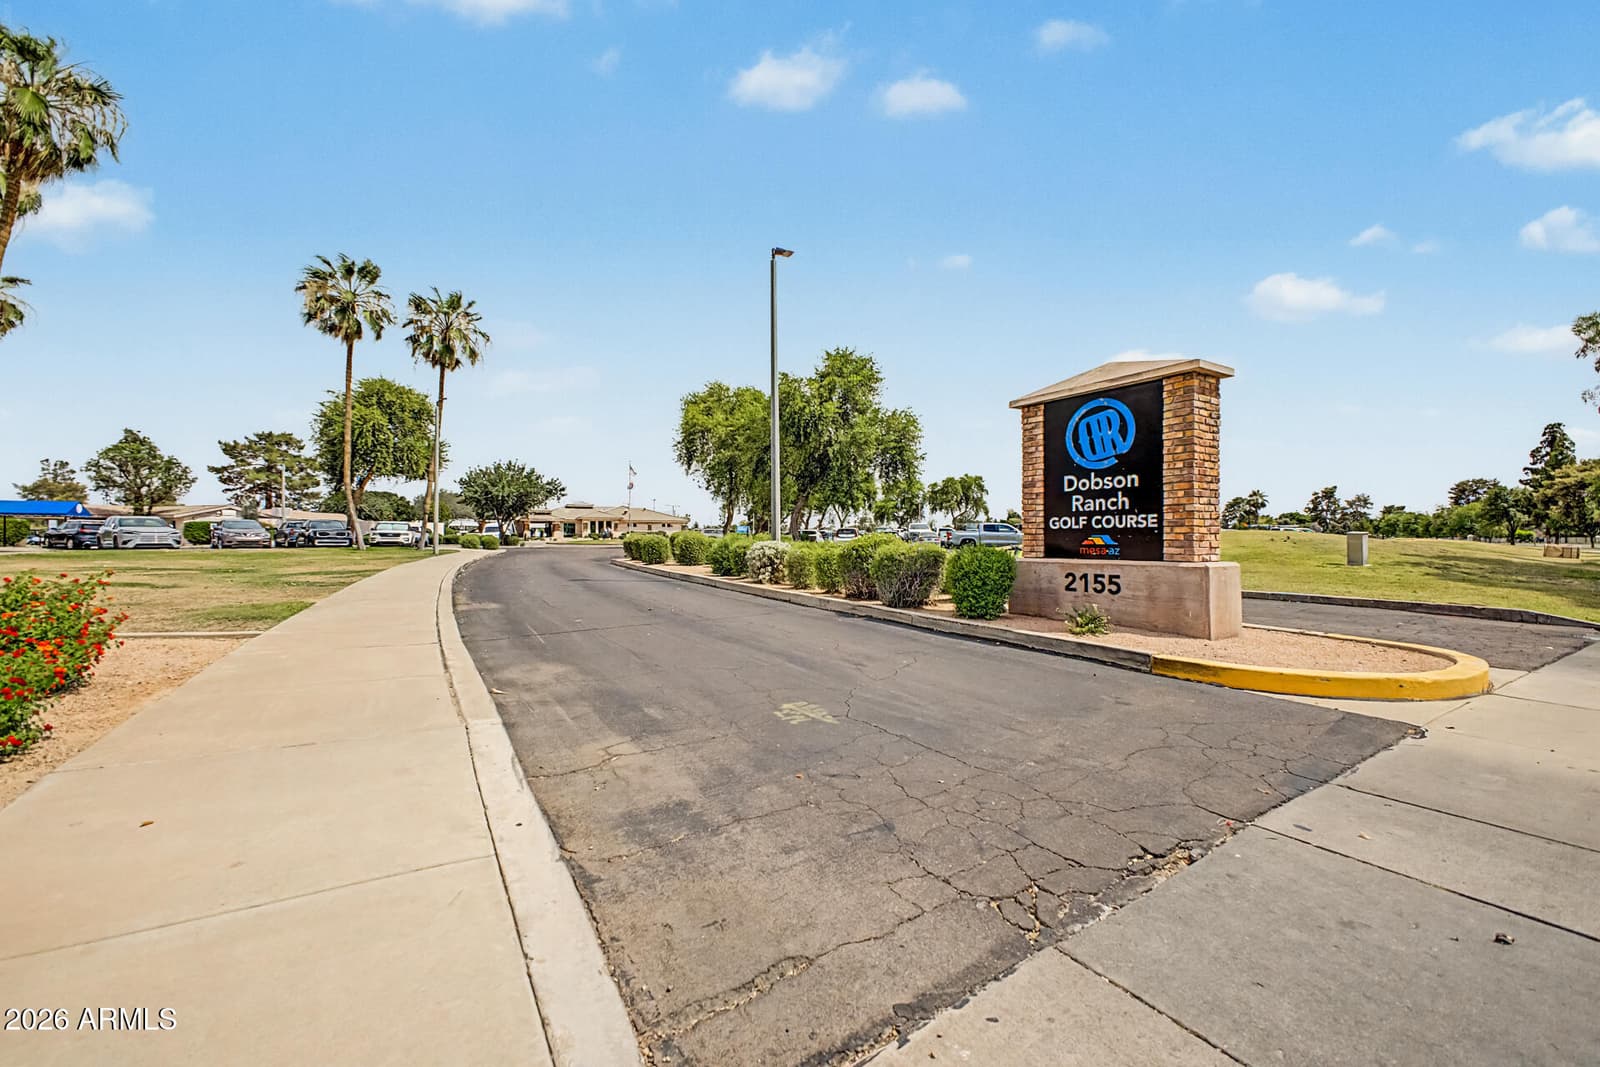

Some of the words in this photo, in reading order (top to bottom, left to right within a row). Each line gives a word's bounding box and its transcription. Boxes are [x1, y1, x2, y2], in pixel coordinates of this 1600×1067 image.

[1063, 472, 1139, 492] Dobson
[1071, 491, 1129, 512] Ranch
[1049, 516, 1088, 529] GOLF
[1091, 513, 1158, 529] COURSE
[1064, 572, 1121, 595] 2155
